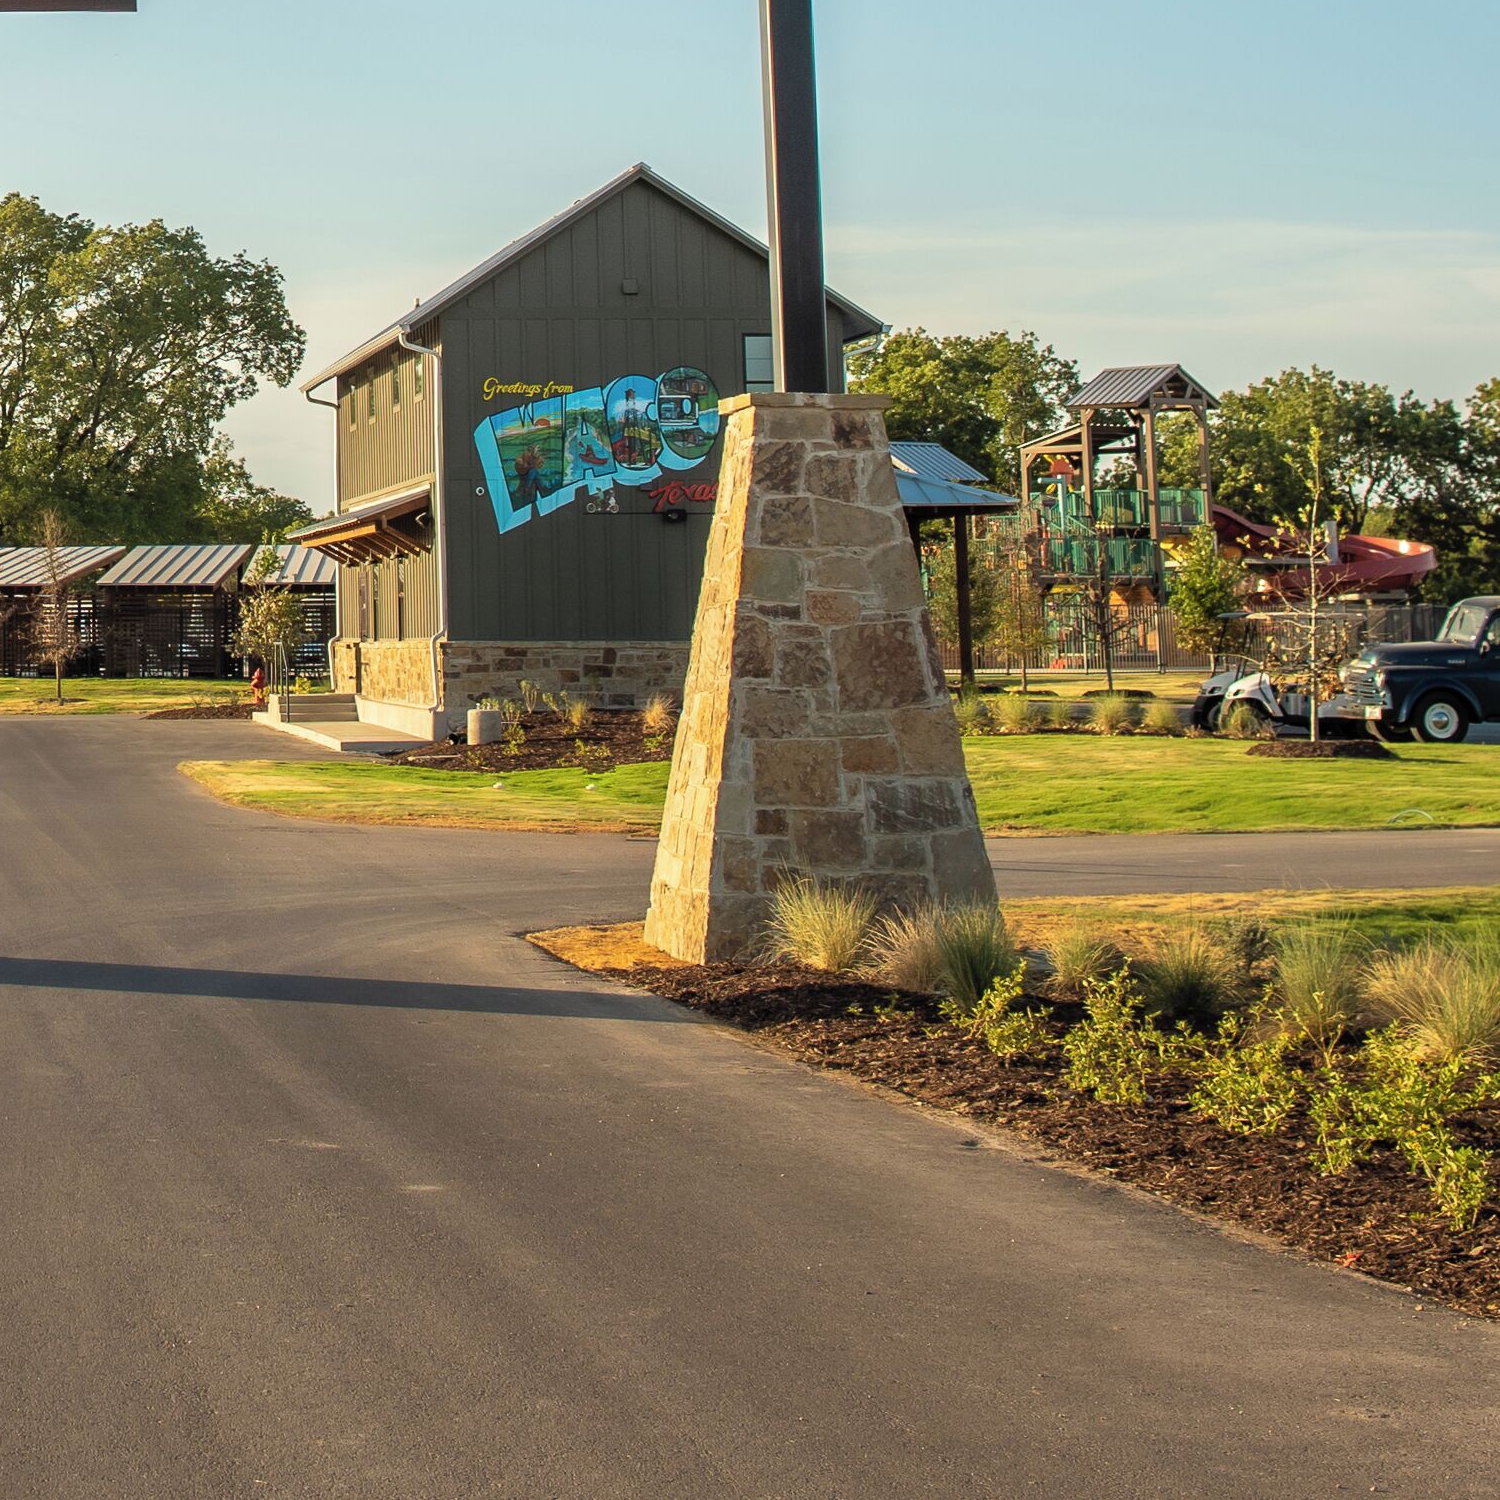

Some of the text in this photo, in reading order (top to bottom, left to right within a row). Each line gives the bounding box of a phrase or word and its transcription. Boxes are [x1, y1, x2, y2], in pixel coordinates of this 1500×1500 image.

[482, 376, 574, 401] Greetings from
[474, 366, 721, 534] WACO
